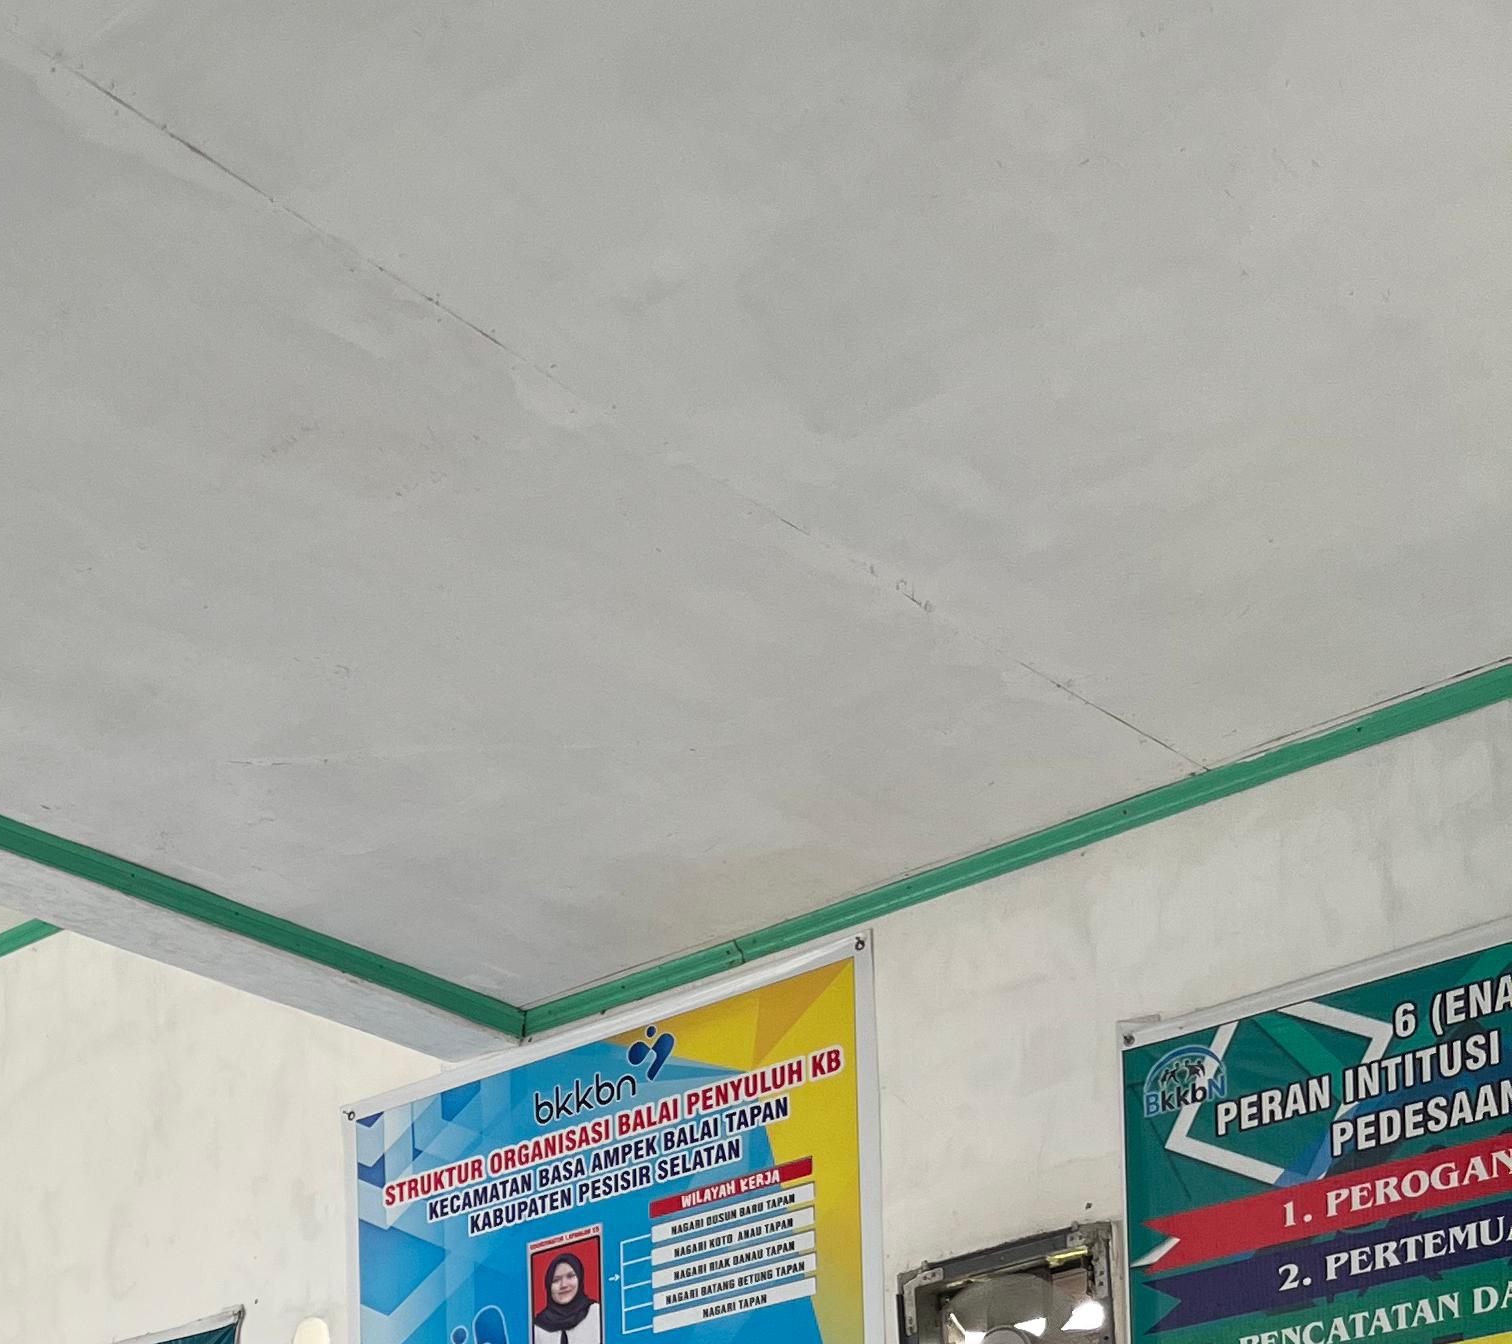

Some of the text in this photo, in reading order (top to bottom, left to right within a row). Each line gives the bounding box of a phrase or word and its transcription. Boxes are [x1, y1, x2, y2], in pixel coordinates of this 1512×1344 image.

[1394, 1002, 1416, 1038] 6
[536, 1074, 636, 1124] bkkbn
[1144, 1077, 1226, 1116] BkkbN
[1217, 1030, 1500, 1136] PERAN INTITUSI
[384, 1049, 841, 1207] STRUKTUR ORGANISASI BALAI PENYULUH KB
[429, 1096, 788, 1220] KECAMATAN BASA AMPEK BALAI TAPAN
[470, 1139, 740, 1234] KABUPATEN PESISIR SELATAN
[681, 1170, 780, 1208] WILAYAH KERJA
[671, 1194, 795, 1234] NAGARI DUSUN BARU TAPAN
[1284, 1202, 1312, 1227] 1.
[1278, 1216, 1512, 1291] 2. PERTEMU
